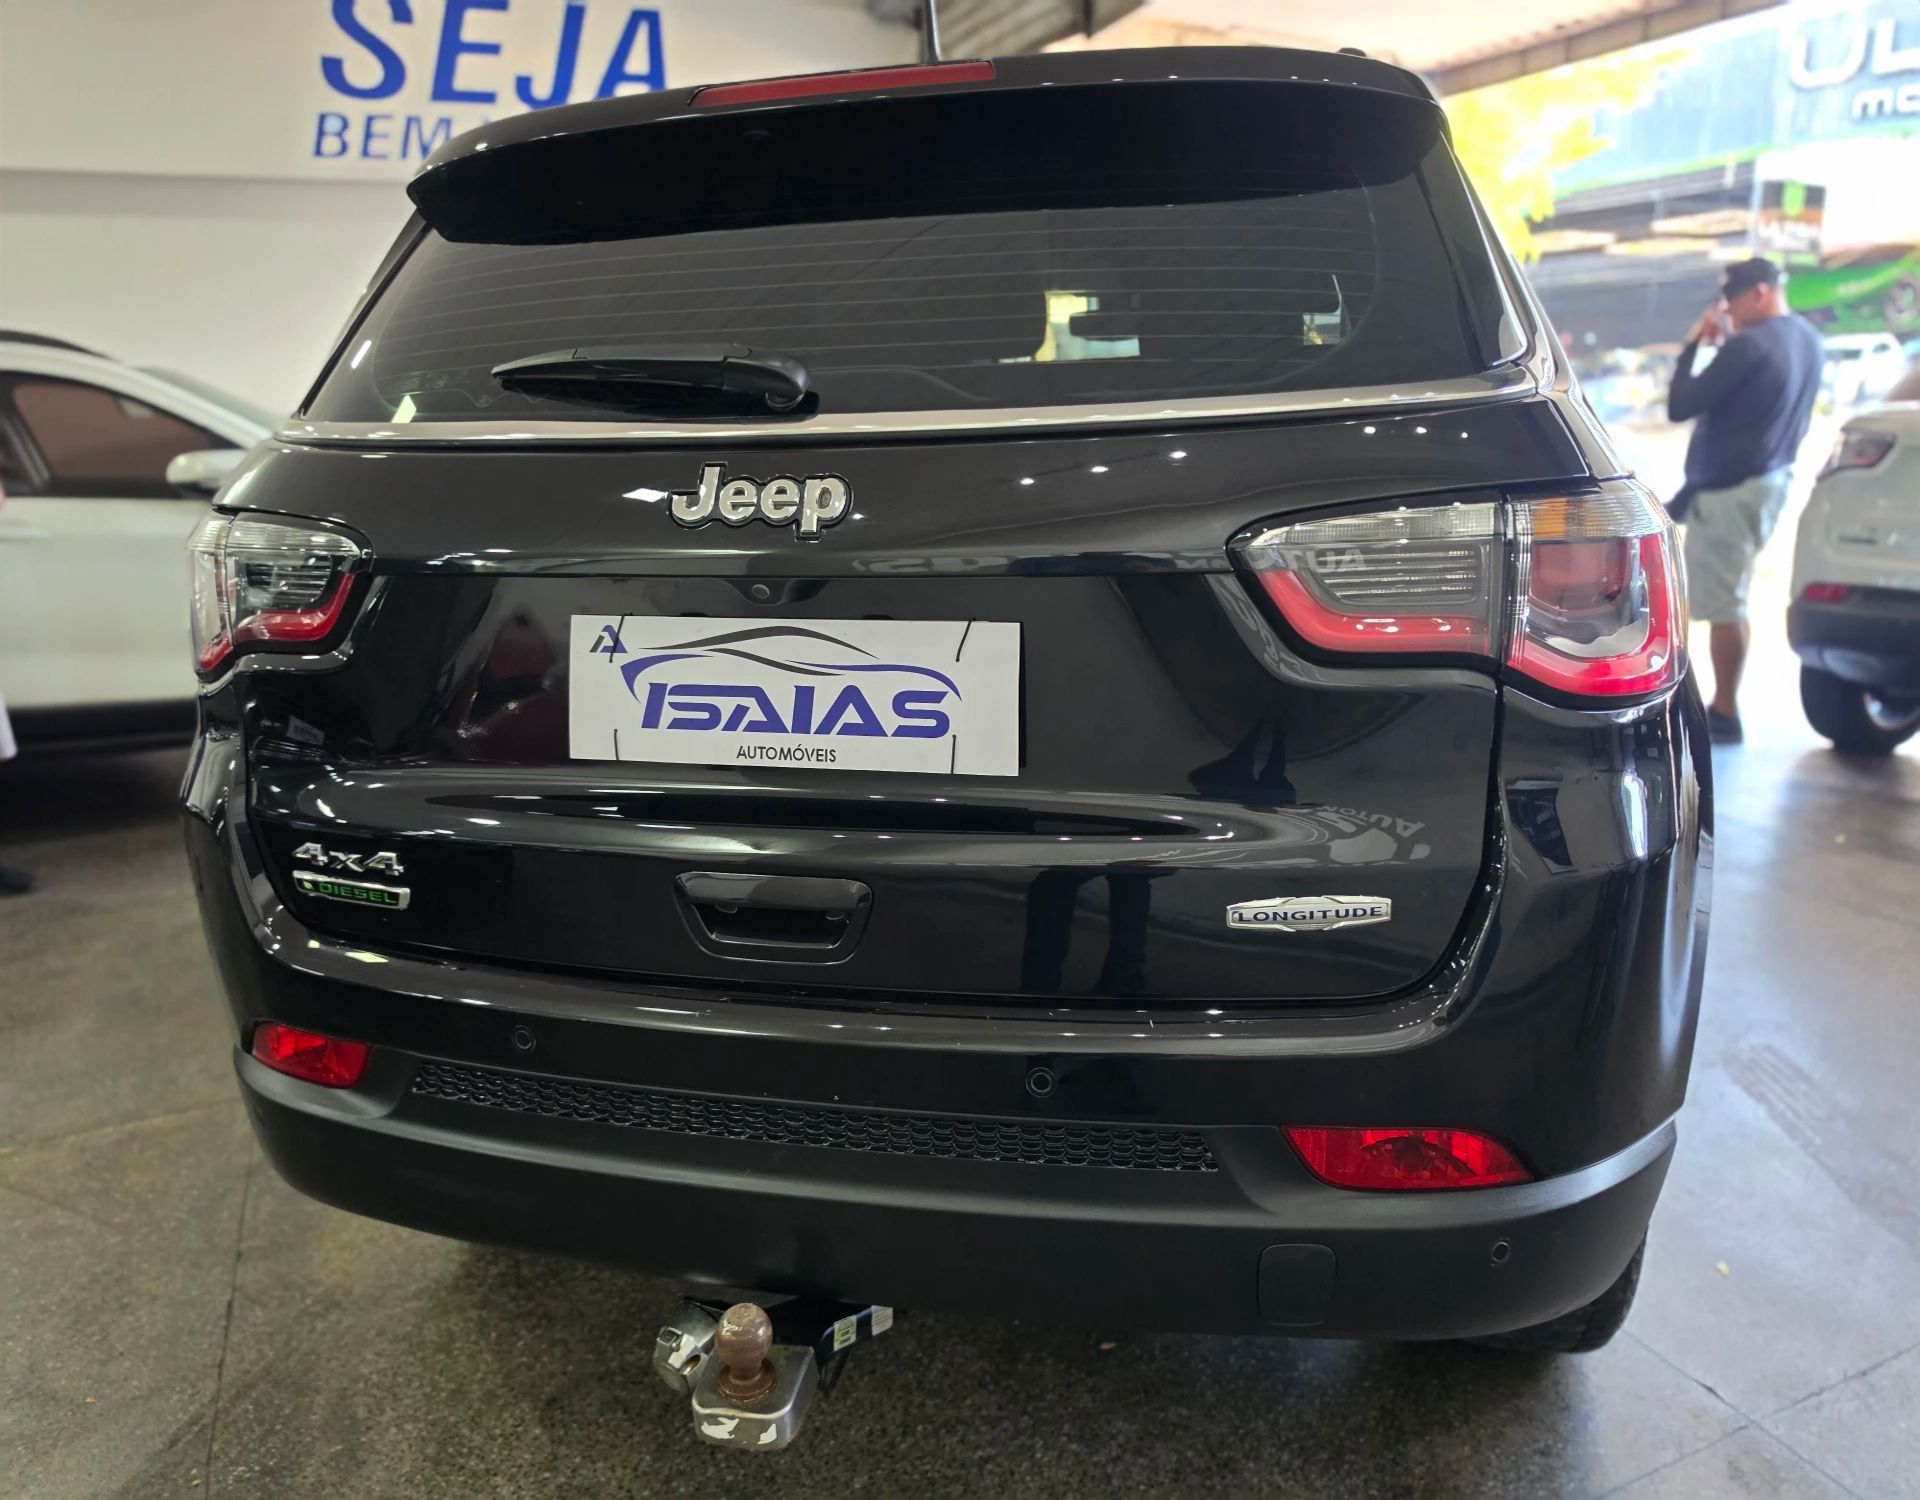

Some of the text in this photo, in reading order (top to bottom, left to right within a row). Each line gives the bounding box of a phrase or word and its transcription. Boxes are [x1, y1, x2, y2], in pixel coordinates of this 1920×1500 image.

[320, 0, 667, 111] SEJA
[313, 112, 453, 159] BEM
[670, 464, 849, 536] Jeep
[641, 682, 950, 739] ISAIAS
[736, 744, 837, 763] AUTOMÓVEIS
[292, 842, 404, 876] 4x4
[319, 880, 397, 904] DIESEL
[1237, 906, 1383, 923] LONGITUDE
